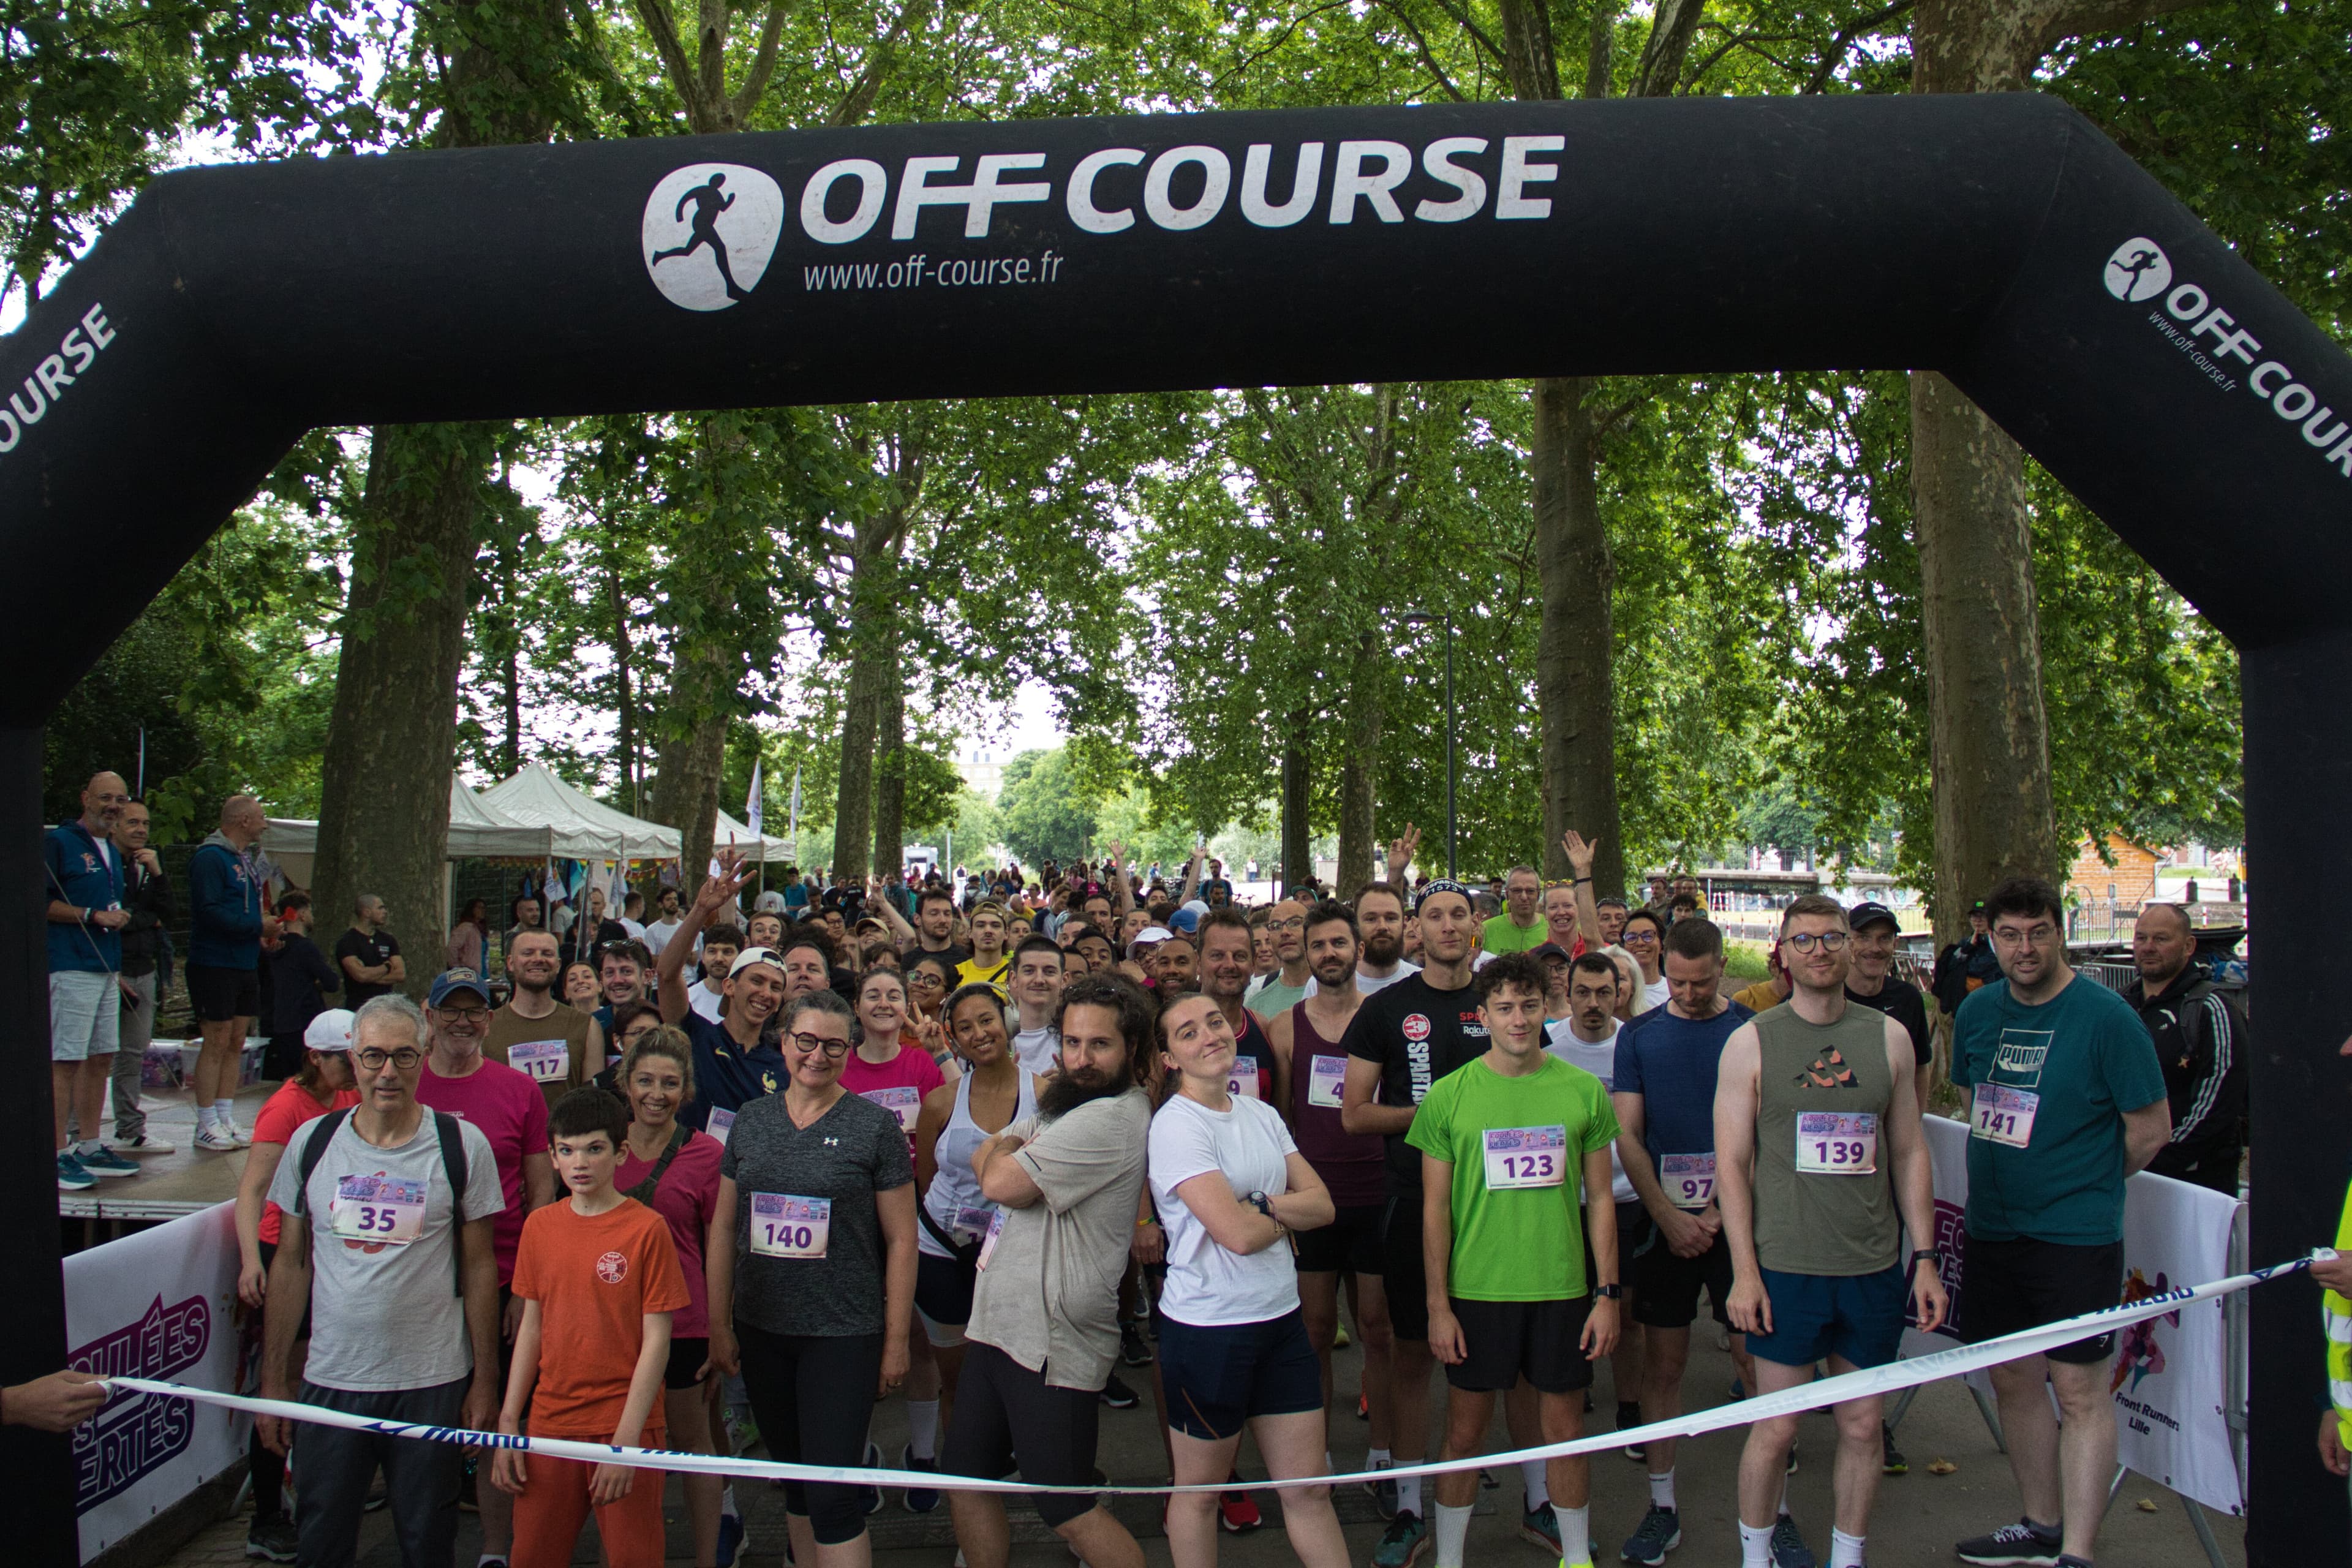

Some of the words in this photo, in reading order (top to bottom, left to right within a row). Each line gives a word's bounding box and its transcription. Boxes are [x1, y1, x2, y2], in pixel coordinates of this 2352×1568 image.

[804, 251, 1063, 291] www.off-course.fr
[2148, 311, 2237, 393] www.off-course.fr
[524, 1059, 559, 1076] 117
[1998, 1044, 2047, 1066] PUMA
[1407, 1042, 1431, 1105] SPARTA
[1227, 1080, 1240, 1095] 9
[1981, 1109, 2016, 1135] 141
[1815, 1141, 1864, 1164] 139
[1503, 1155, 1554, 1178] 123
[1682, 1178, 1713, 1199] 97
[358, 1207, 396, 1232] 35
[765, 1223, 812, 1248] 140
[2115, 1391, 2141, 1412] Front
[2141, 1403, 2180, 1431] Runners
[2128, 1416, 2150, 1434] Lille
[77, 1392, 190, 1494] ERTÉS
